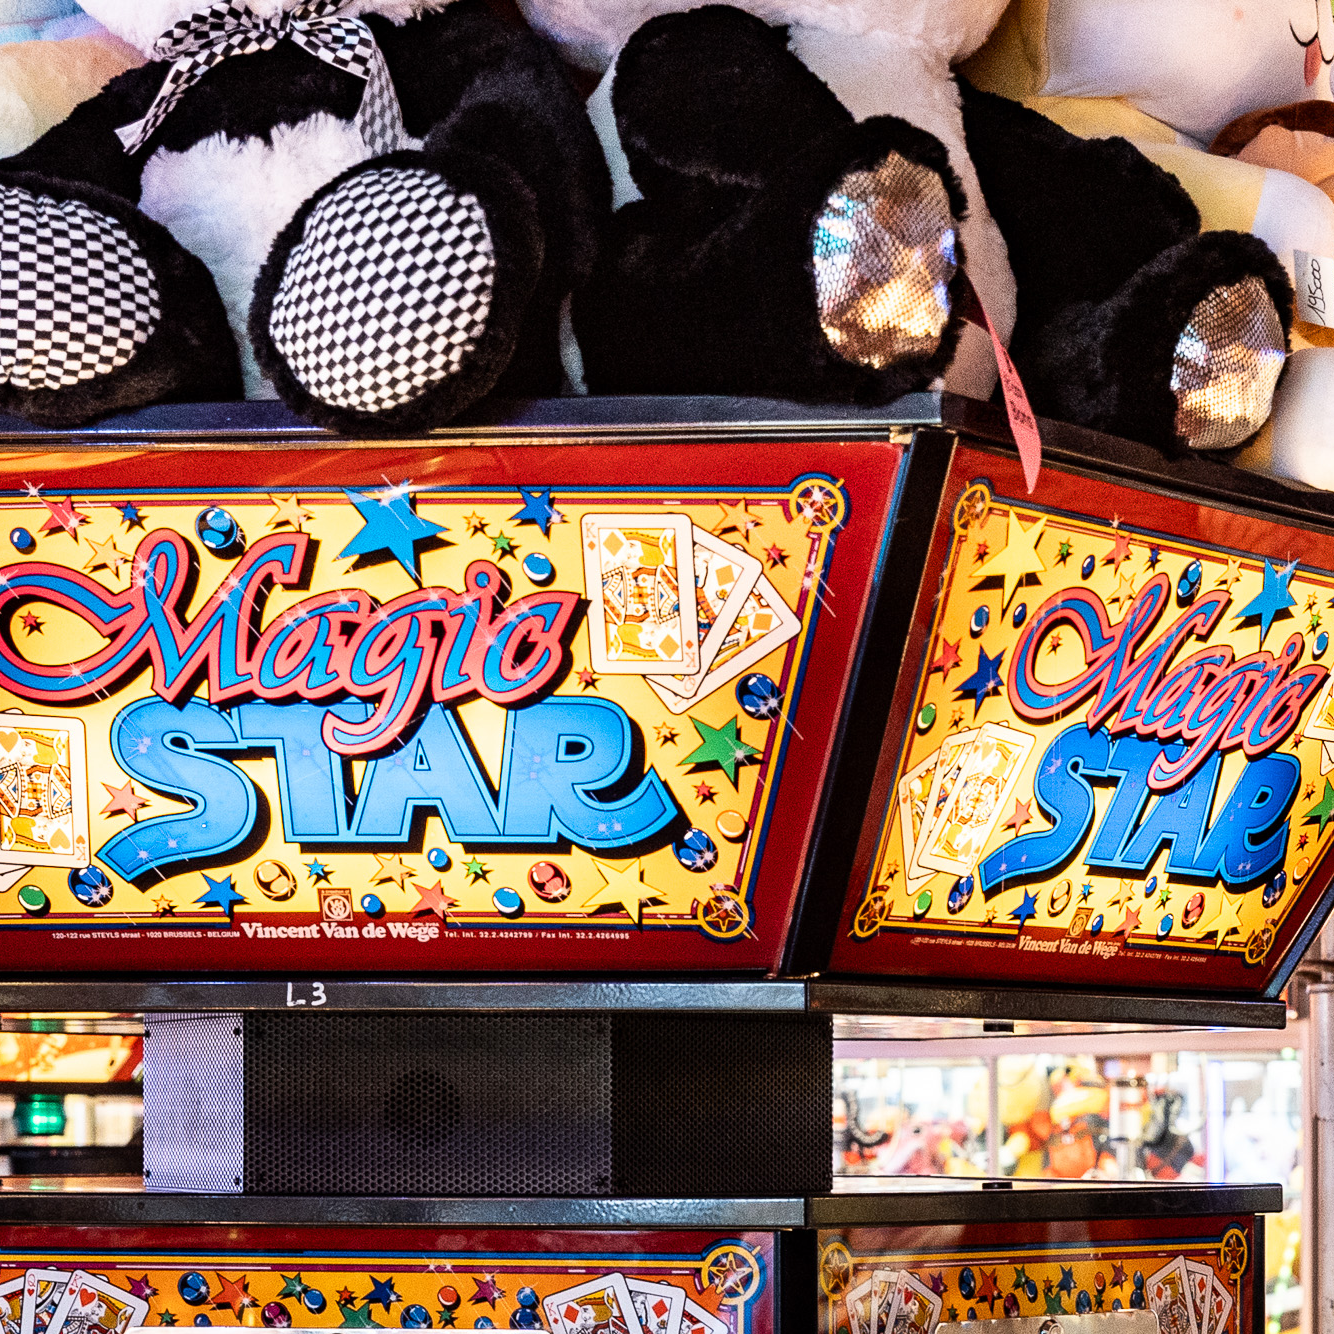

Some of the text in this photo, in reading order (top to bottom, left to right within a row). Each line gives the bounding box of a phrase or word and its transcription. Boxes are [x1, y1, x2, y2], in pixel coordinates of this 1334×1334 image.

[1007, 572, 1331, 791] Magic
[94, 696, 678, 883] STAR
[977, 722, 1304, 895] STAR
[51, 931, 78, 939] 120-122
[92, 931, 120, 939] STEYLS
[163, 930, 206, 938] BRUSSELS
[208, 930, 241, 938] BELGIUM
[240, 922, 440, 943] Vincent Van de Wege
[541, 931, 556, 939] Fax
[1018, 935, 1119, 960] Vincent Van de Wege
